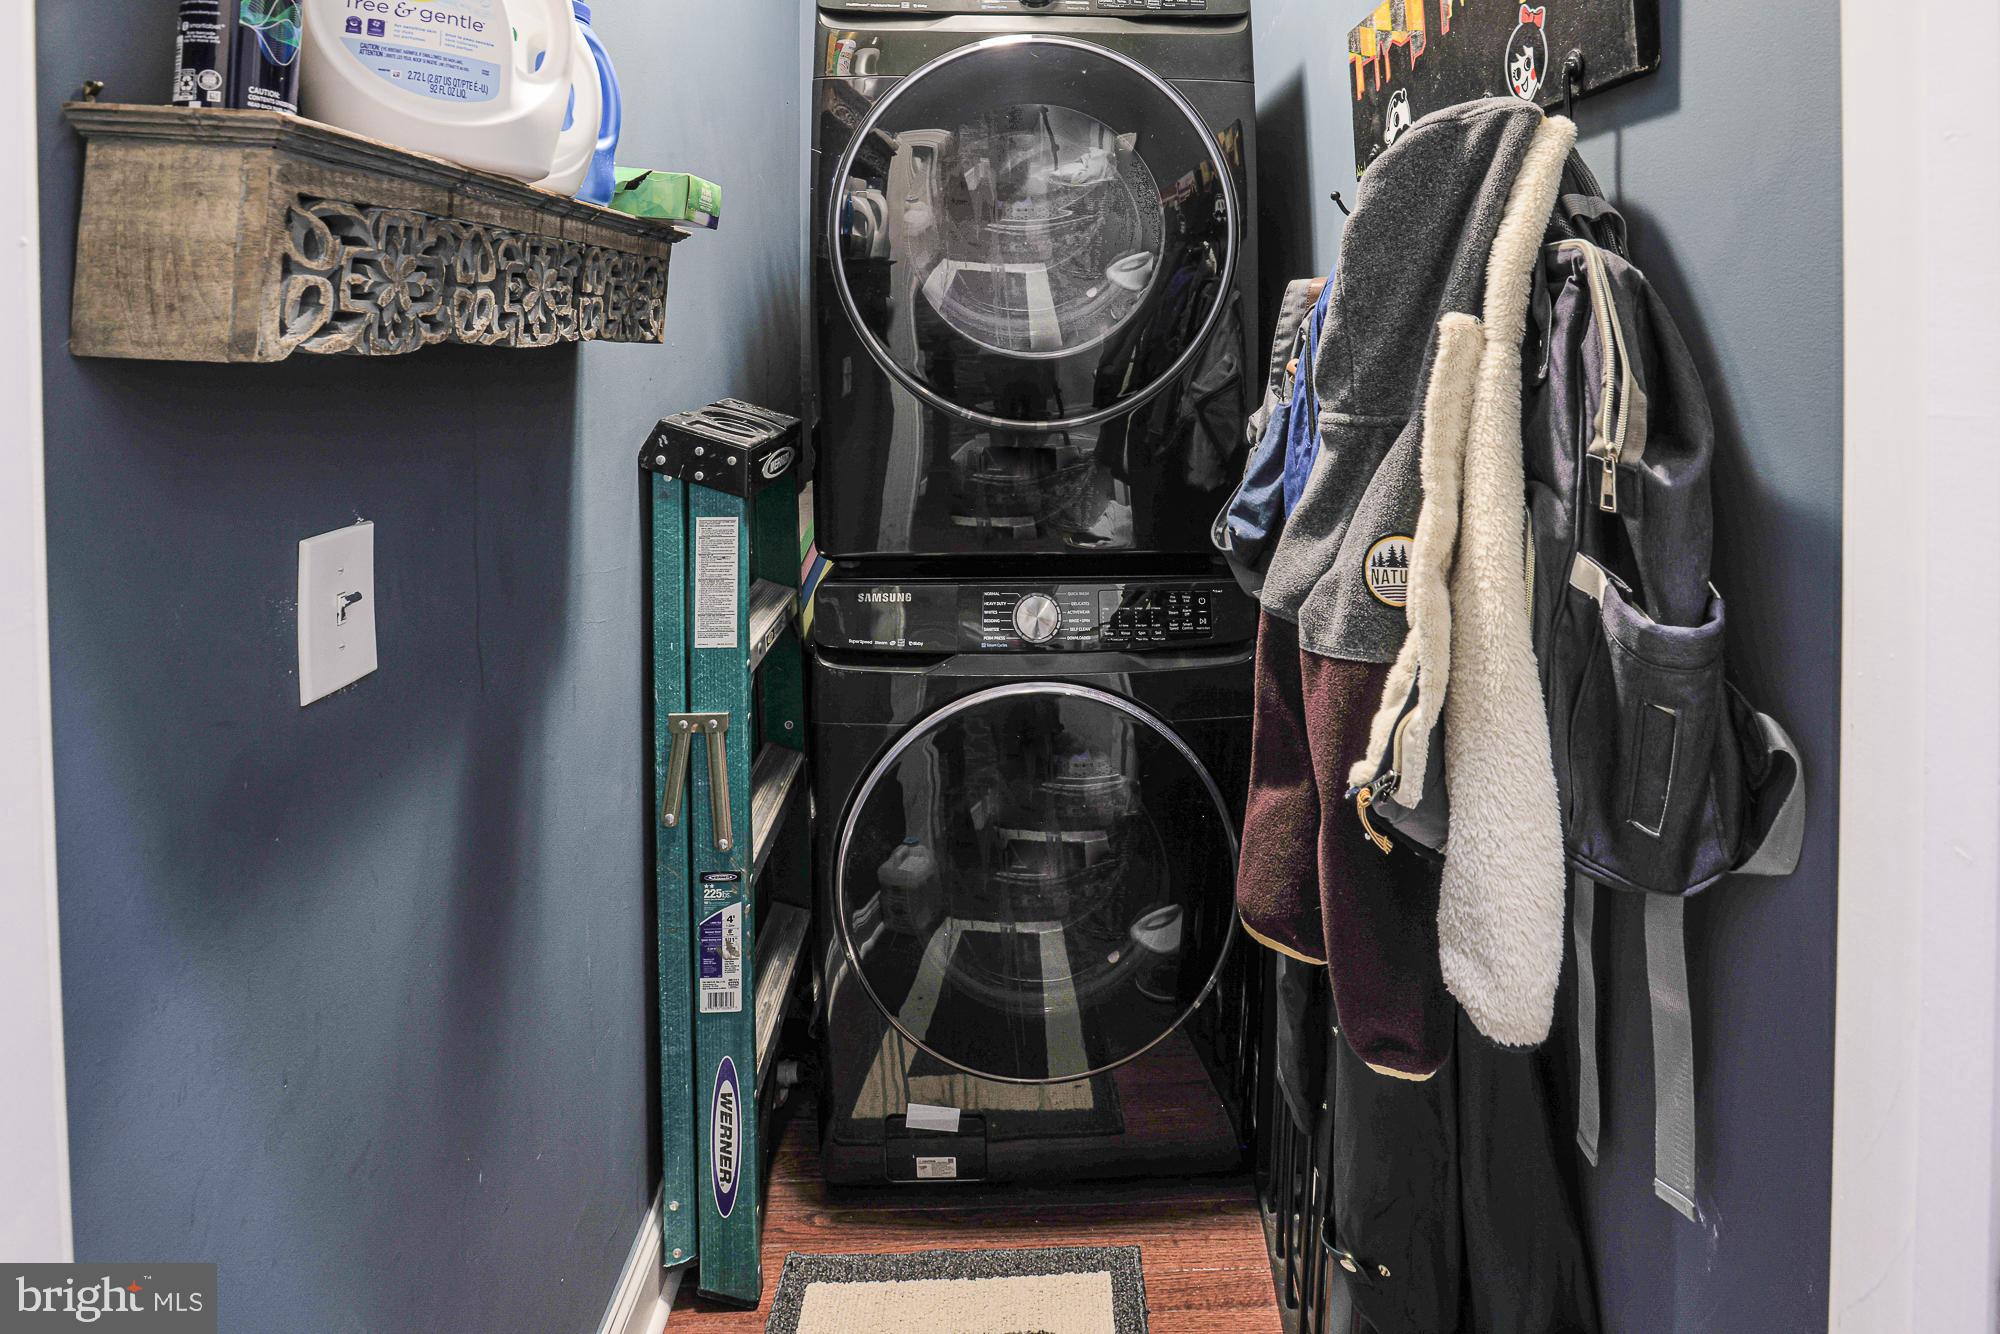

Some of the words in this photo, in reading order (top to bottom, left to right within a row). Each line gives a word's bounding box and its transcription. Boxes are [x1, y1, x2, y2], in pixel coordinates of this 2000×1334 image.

[394, 2, 417, 18] &
[420, 8, 484, 32] gentle
[408, 70, 421, 82] 2.72
[422, 72, 426, 82] L
[427, 73, 442, 85] (2.87
[443, 76, 452, 86] US
[430, 84, 438, 94] 92
[439, 85, 446, 95] FL
[447, 87, 456, 97] OZ
[1371, 568, 1408, 586] NATU
[857, 592, 912, 603] SAMSUNG
[719, 1092, 733, 1185] WERNER
